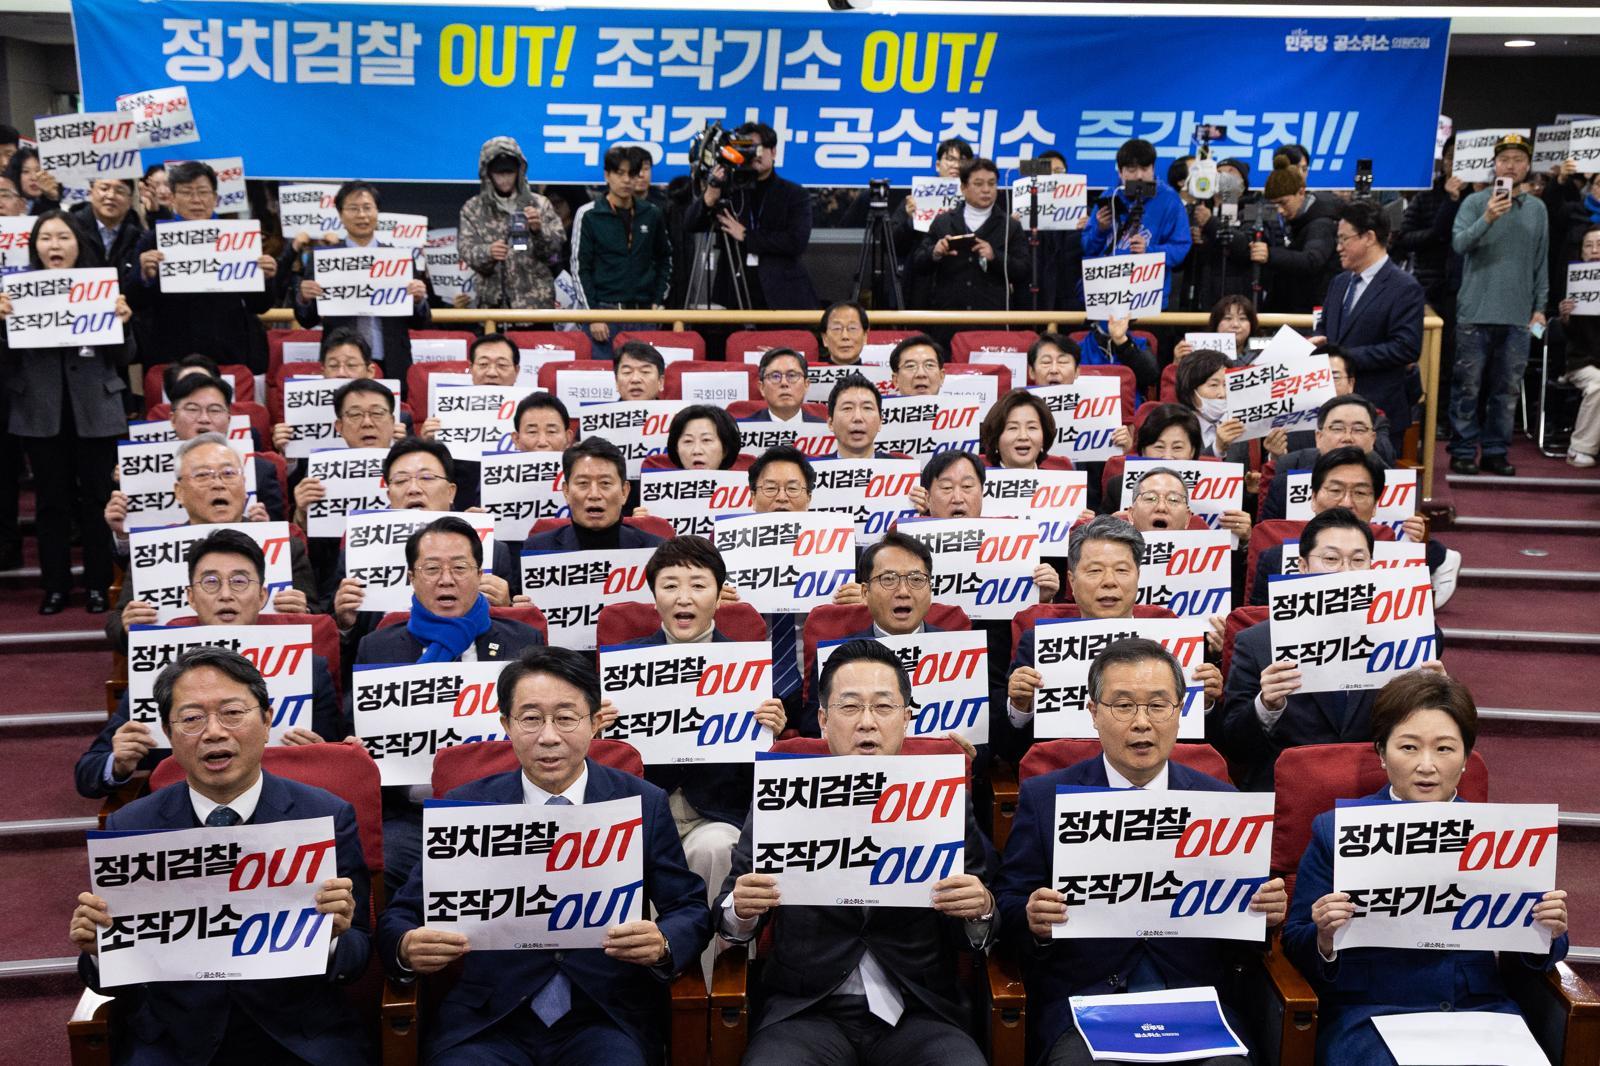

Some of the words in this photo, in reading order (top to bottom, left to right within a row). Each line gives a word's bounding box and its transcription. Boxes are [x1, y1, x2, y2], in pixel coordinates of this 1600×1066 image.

[162, 18, 423, 86] 정치검찰
[439, 24, 576, 89] OUT!
[593, 26, 842, 92] 조작기소
[861, 29, 999, 94] OUT!
[1285, 34, 1328, 52] 민주당
[1334, 34, 1390, 51] 공소취소
[38, 121, 95, 142] 정치검찰
[92, 121, 134, 144] OUT
[42, 151, 99, 171] 조작기소
[97, 150, 139, 171] OUT
[1053, 183, 1086, 199] OUT
[320, 217, 344, 231] OU
[1053, 205, 1087, 221] OUT
[159, 228, 219, 248] 정치검찰
[215, 230, 261, 252] OUT
[376, 220, 398, 231] 검찰
[392, 224, 427, 238] OUT
[161, 260, 222, 277] 조작기소
[217, 261, 258, 281] OUT
[317, 256, 374, 273] 정치검찰
[369, 258, 413, 278] OUT
[1084, 262, 1135, 281] 정치검찰
[1130, 262, 1165, 284] OUT
[7, 278, 73, 300] 정치검찰
[69, 280, 119, 303] OUT
[320, 284, 374, 301] 조작기소
[370, 287, 408, 305] OUT
[1086, 290, 1134, 307] 조작기소
[1129, 289, 1163, 310] OUT
[10, 311, 75, 332] 조작기소
[72, 312, 116, 334] OUT
[568, 387, 613, 399] 국회의원
[693, 388, 737, 400] 국회의원
[1229, 364, 1289, 391] 공소취소
[1271, 376, 1301, 399] 즉각
[1303, 368, 1331, 391] 추진
[288, 389, 336, 409] 정치검
[438, 394, 504, 412] 정치검찰
[1046, 393, 1081, 412] 검찰
[1074, 395, 1121, 419] OUT
[582, 409, 648, 432] 정치검찰
[642, 416, 673, 436] OU
[932, 406, 979, 430] OUT
[1232, 397, 1295, 424] 국정조사
[1271, 413, 1301, 429] 즉각
[1303, 406, 1321, 423] 추
[289, 421, 341, 441] 조작기
[438, 427, 502, 443] 조작기소
[620, 443, 648, 461] 기소
[874, 438, 937, 455] 조작기소
[311, 459, 384, 480] 정치검찰
[483, 462, 560, 485] 정치검찰
[643, 480, 718, 501] 정치검찰
[708, 486, 752, 509] OU
[812, 469, 873, 490] 치검찰
[865, 473, 920, 498] OUT
[983, 480, 1039, 498] 치검찰
[1031, 484, 1087, 508] OUT
[1192, 477, 1243, 500] OUT
[1374, 482, 1416, 507] UT
[309, 496, 385, 518] 조작기소
[717, 523, 802, 551] 정치검찰
[793, 528, 855, 556] OUT
[976, 534, 1040, 564] OUT
[1140, 542, 1173, 566] 검찰
[1166, 545, 1230, 576] OUT
[524, 561, 612, 589] 정치검찰
[603, 565, 648, 595] OU
[793, 568, 856, 598] OUT
[976, 576, 1033, 606] OUT
[1168, 587, 1231, 617] OUT
[1272, 584, 1376, 621] 정치검찰
[1366, 585, 1432, 625] OUT
[912, 647, 987, 686] OUT
[1275, 635, 1375, 668] 조작기소
[1366, 634, 1436, 674] OUT
[604, 656, 707, 691] 정치검찰
[696, 659, 772, 697] OUT
[357, 675, 464, 712] 정치검찰
[453, 682, 500, 717] OU
[605, 707, 705, 740] 조작기소
[697, 710, 764, 746] OUT
[914, 697, 990, 735] OUT
[757, 772, 888, 811] 정치검찰
[871, 776, 965, 824] OUT
[427, 821, 559, 859] 정치검찰
[545, 816, 643, 872] OUT
[1058, 807, 1191, 844] 정치검찰
[1174, 814, 1275, 859] OUT
[1338, 819, 1475, 858] 정치검찰
[1458, 826, 1559, 871] OUT
[94, 842, 242, 888] 정치검찰
[229, 838, 337, 892] OUT
[755, 836, 882, 874] 조작기소
[870, 840, 965, 885] OUT
[427, 884, 558, 922] 조작기소
[547, 879, 643, 932] OUT
[1056, 870, 1184, 907] 조작기소
[1170, 876, 1270, 918] OUT
[1340, 883, 1467, 918] 조작기소
[1452, 891, 1547, 930] OUT
[100, 903, 243, 953] 조작기소
[231, 906, 326, 957] OUT
